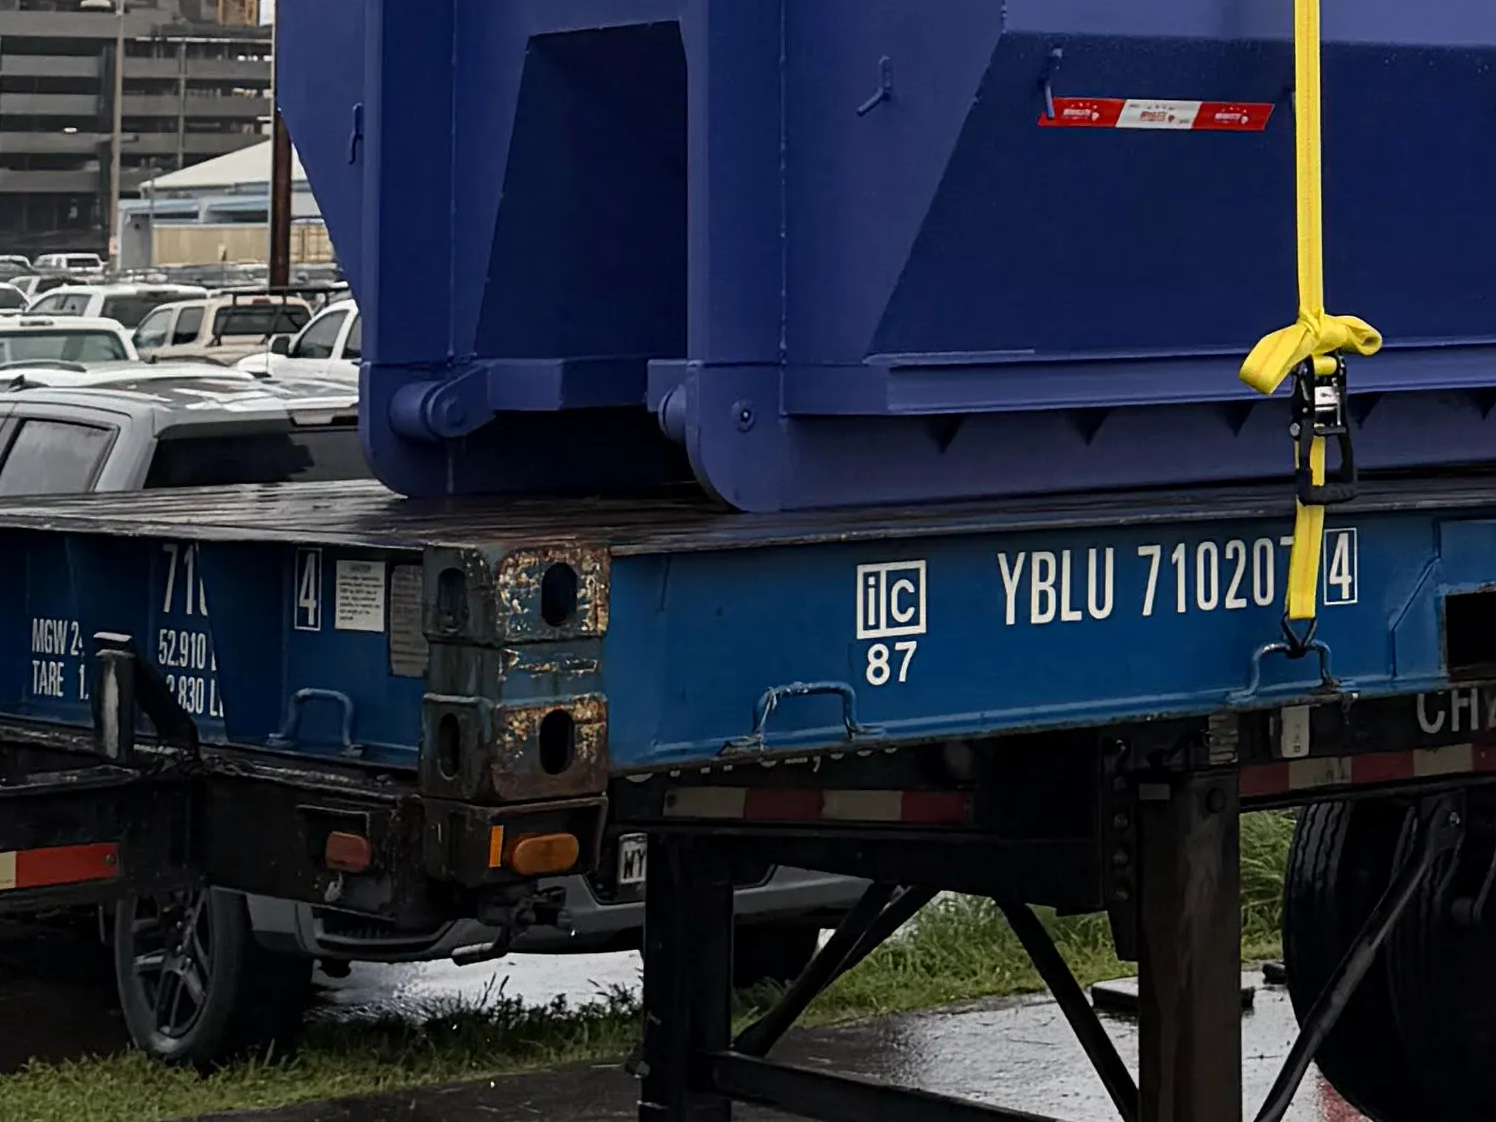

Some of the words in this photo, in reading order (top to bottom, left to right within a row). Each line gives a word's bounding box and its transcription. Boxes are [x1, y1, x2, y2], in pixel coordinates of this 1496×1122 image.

[162, 543, 208, 616] 71
[299, 552, 317, 626] 4
[997, 547, 1114, 626] YBLU
[1329, 532, 1352, 600] 4
[32, 618, 68, 655] MGW
[158, 629, 207, 670] 52.910
[32, 660, 65, 698] TARE
[865, 641, 918, 686] 87
